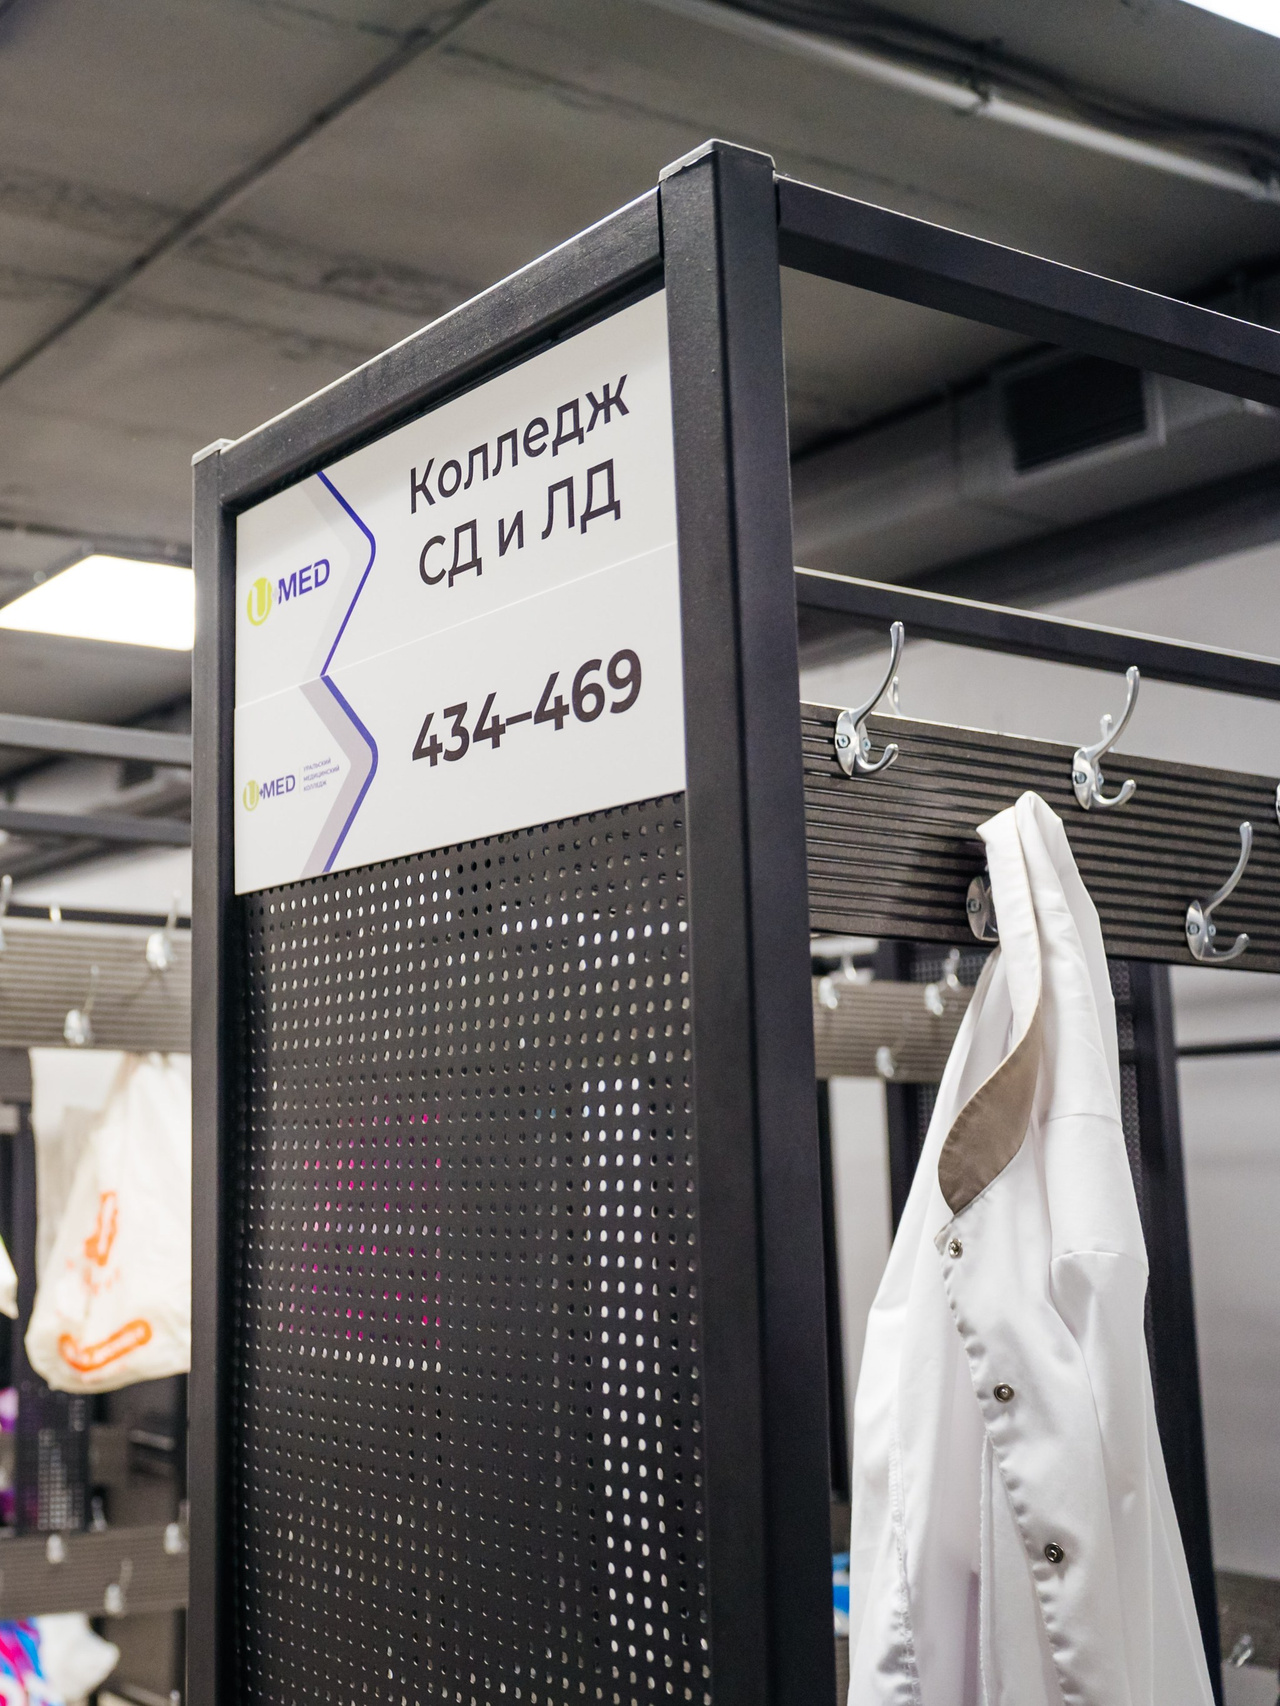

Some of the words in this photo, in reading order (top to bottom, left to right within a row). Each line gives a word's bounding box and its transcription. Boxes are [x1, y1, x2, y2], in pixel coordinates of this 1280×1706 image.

[410, 374, 630, 515] Колледж
[419, 518, 482, 588] СД
[498, 510, 524, 557] и
[541, 458, 621, 540] ЛД
[411, 648, 642, 768] 434–469
